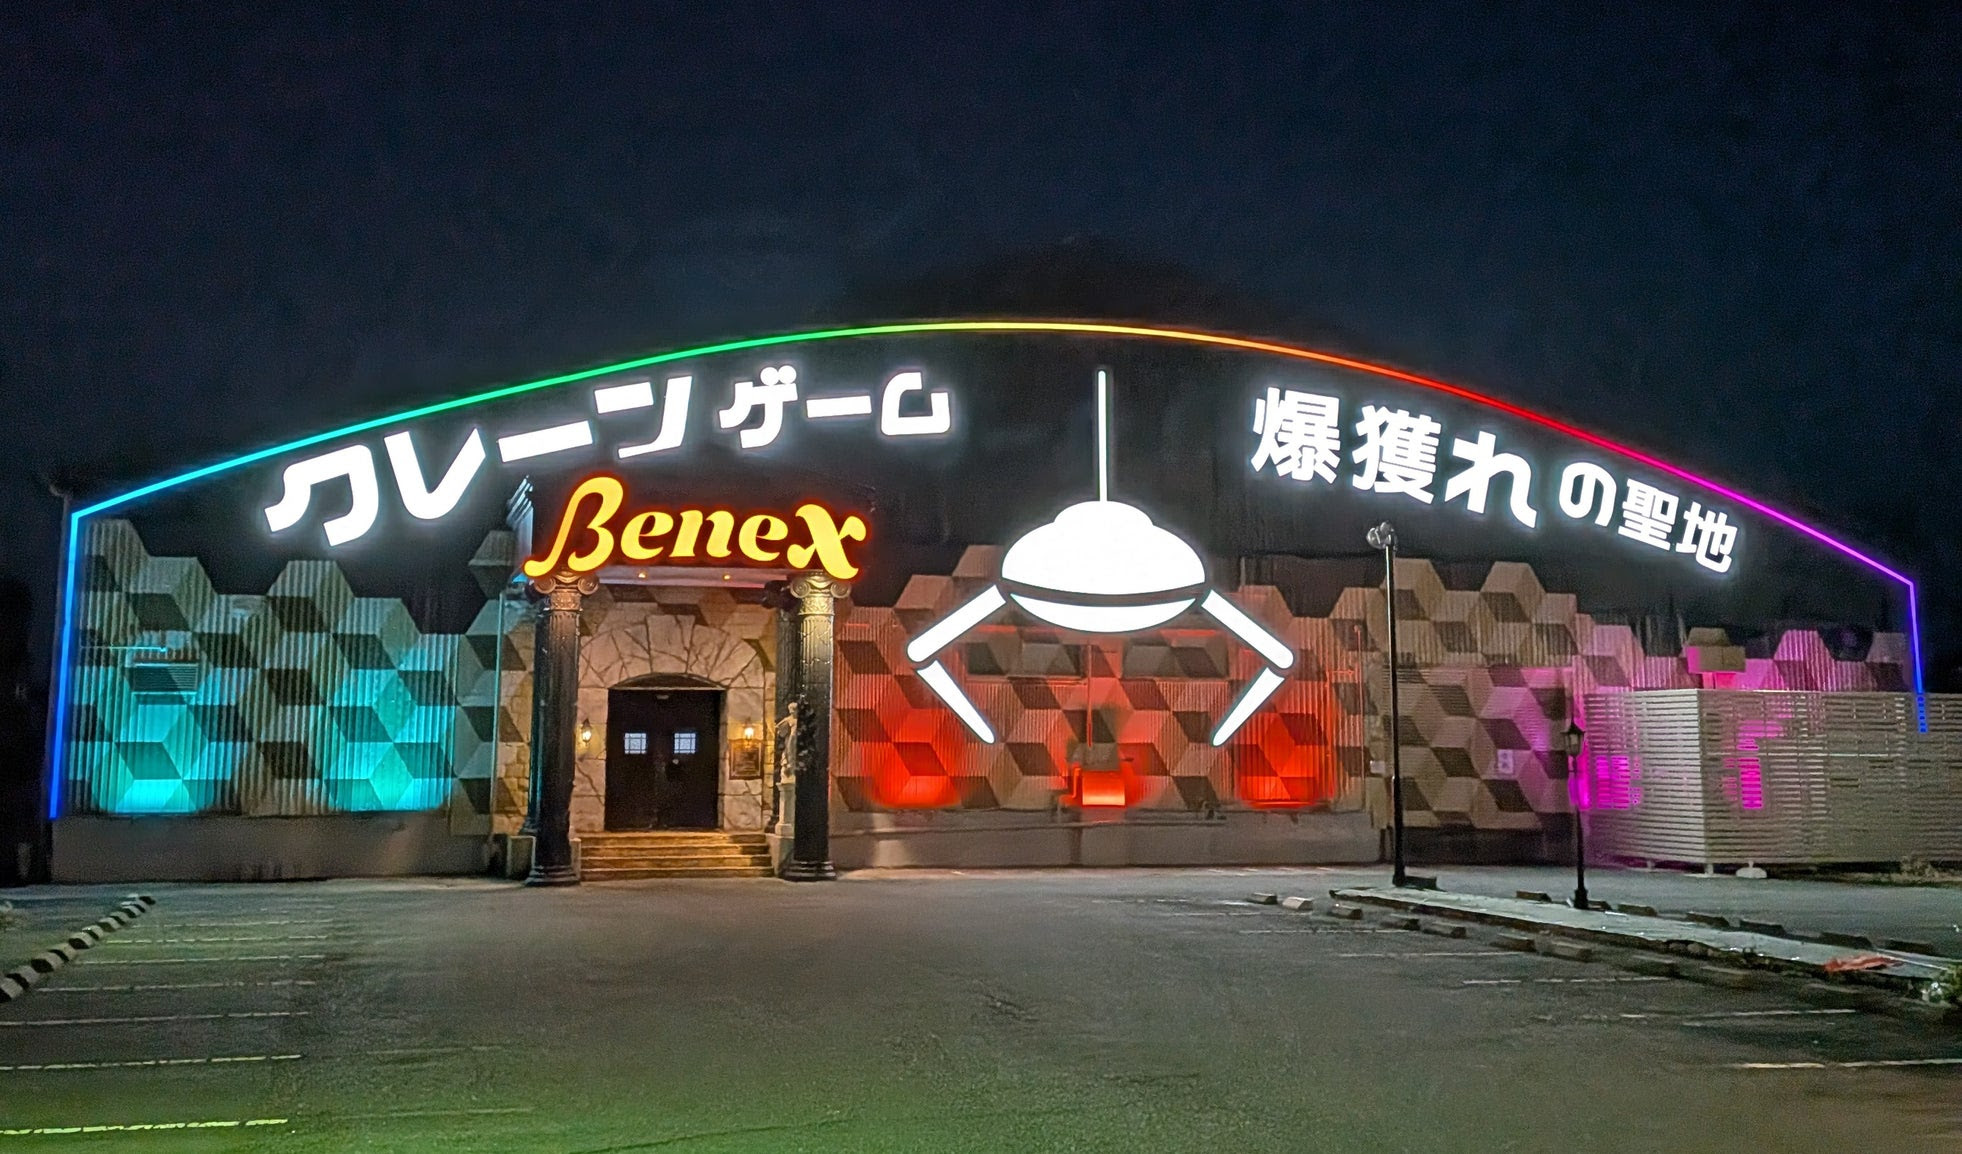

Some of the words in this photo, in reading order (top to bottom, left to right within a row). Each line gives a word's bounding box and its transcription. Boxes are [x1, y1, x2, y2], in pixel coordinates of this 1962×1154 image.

[264, 365, 951, 547] クレーンゲーム
[1250, 386, 1738, 574] 爆獲れの聖地
